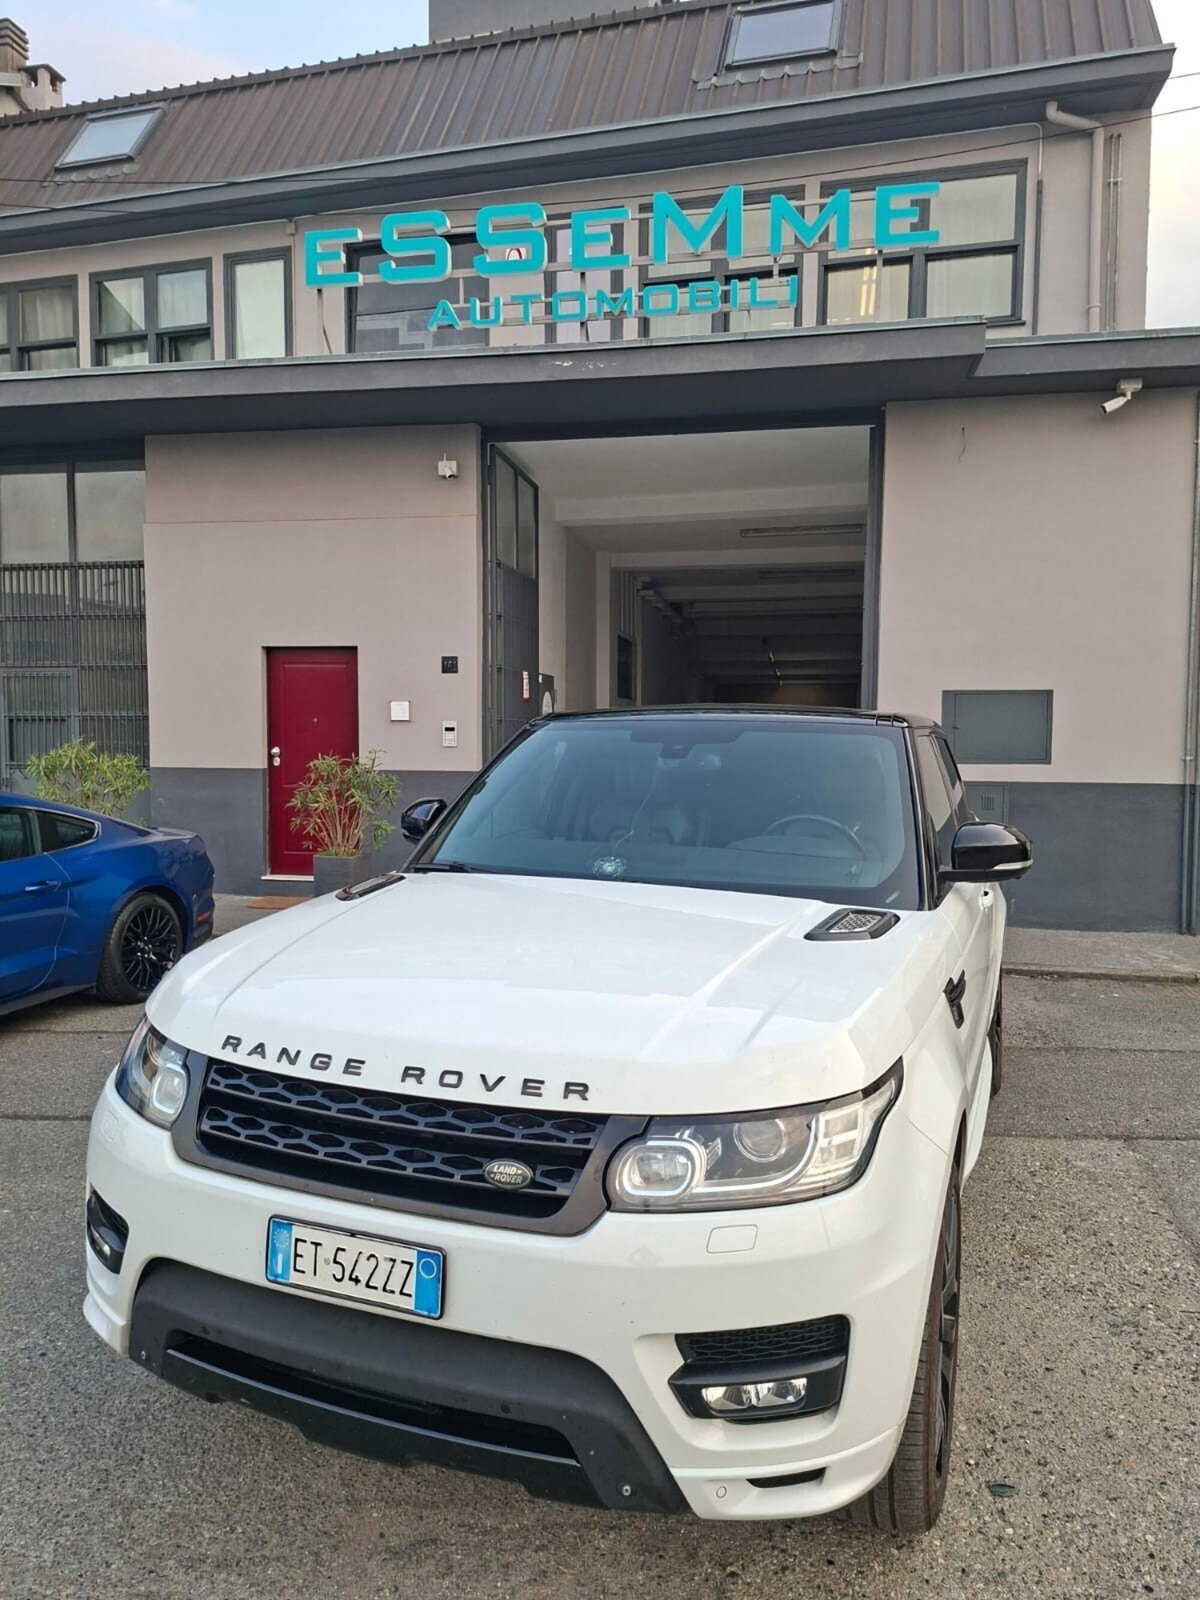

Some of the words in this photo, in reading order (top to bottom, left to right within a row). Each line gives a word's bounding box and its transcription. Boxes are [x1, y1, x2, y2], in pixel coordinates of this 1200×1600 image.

[304, 182, 941, 288] ESSEMME
[427, 275, 798, 331] AUTOMOBILI
[221, 1034, 366, 1077] RANGE
[400, 1065, 590, 1101] ROVER
[493, 1164, 517, 1175] LAND
[494, 1172, 523, 1184] ROVER
